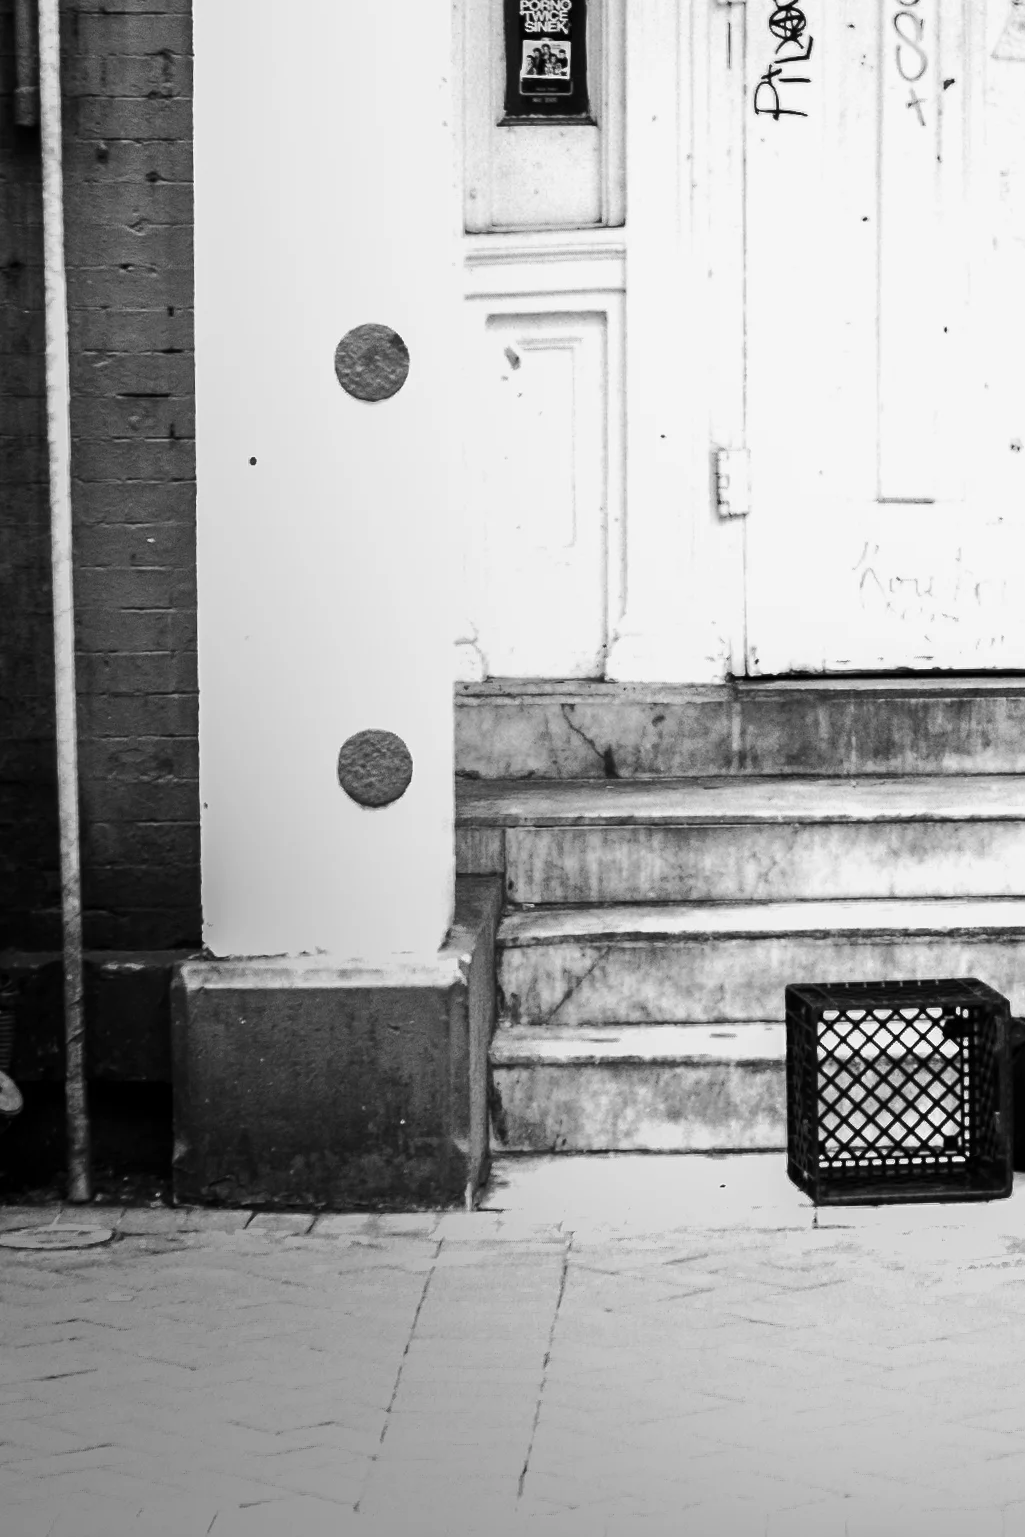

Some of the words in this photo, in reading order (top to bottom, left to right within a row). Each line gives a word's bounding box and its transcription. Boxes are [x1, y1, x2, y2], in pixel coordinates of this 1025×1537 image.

[520, 0, 573, 12] PORNO
[519, 10, 569, 22] TWICE
[524, 21, 571, 35] SINEK
